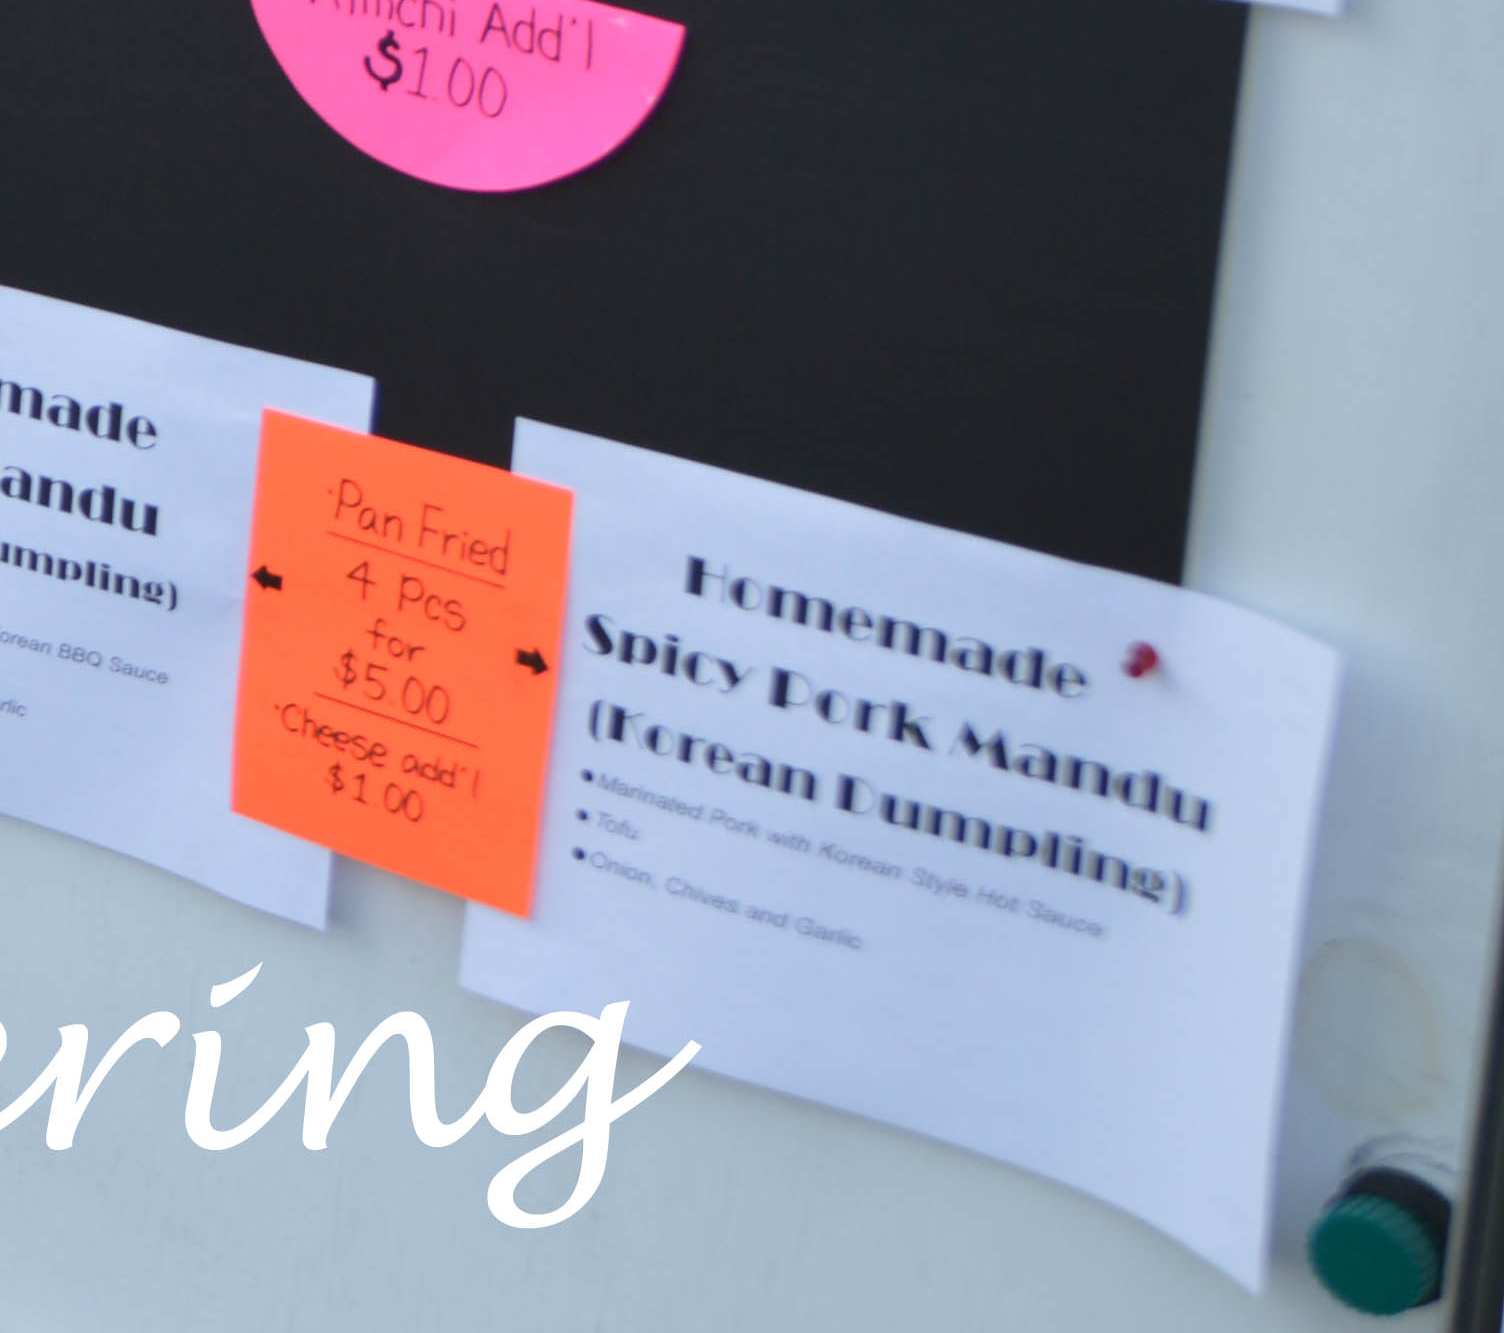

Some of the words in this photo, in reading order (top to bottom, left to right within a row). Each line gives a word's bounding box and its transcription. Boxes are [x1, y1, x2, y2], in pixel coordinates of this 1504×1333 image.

[335, 478, 404, 542] Pan
[418, 502, 511, 576] Fried
[346, 560, 377, 601] 4
[55, 641, 104, 670] BBQ
[107, 654, 172, 687] Sauce
[365, 617, 426, 662] for
[685, 555, 1089, 697] Homemade
[280, 702, 388, 768] Cheese
[585, 613, 750, 690] Spicy
[769, 666, 932, 752] Pork
[950, 722, 1211, 834] Mandu
[588, 699, 819, 802] (Korean
[835, 773, 1187, 916] Dumpling)
